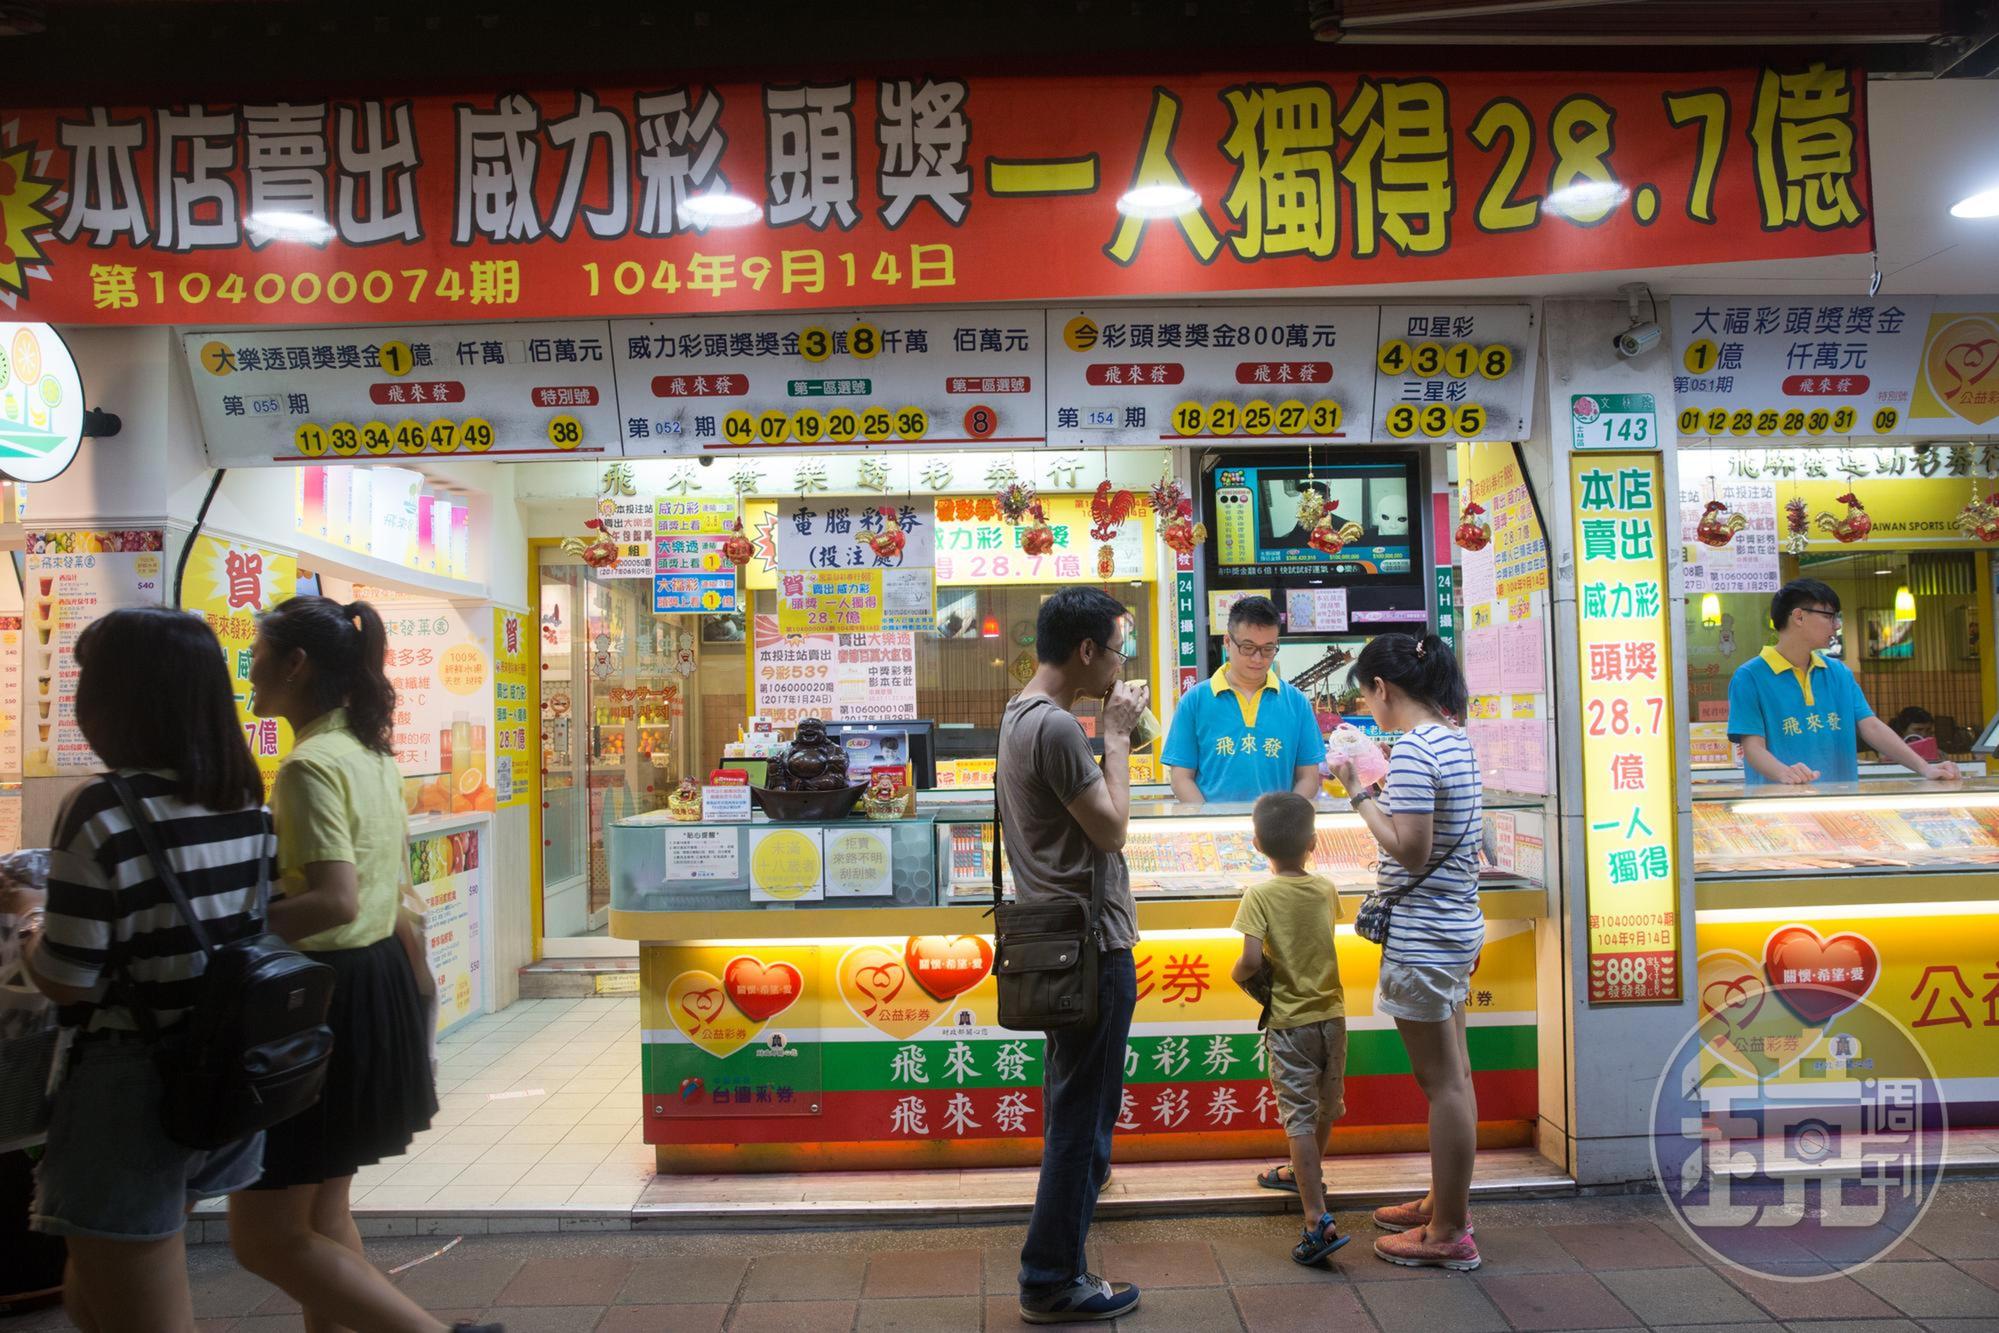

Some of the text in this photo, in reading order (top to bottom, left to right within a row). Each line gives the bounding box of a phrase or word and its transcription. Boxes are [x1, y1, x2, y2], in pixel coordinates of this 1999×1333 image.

[57, 100, 424, 250] 本店賣出
[454, 91, 727, 243] 威力彩
[765, 80, 971, 231] 頭獎
[90, 242, 956, 310] 第104000074期 104年9月14日
[1408, 316, 1475, 338] 四星彩
[1691, 306, 1906, 335] 大福彩頭獎獎金
[953, 327, 1029, 353] 佰萬元
[1074, 323, 1336, 350] 今彩頭獎獎金800萬元
[456, 340, 505, 365] 仟萬
[529, 338, 603, 364] 佰萬元
[1383, 345, 1505, 373] 4 3 1 8
[1786, 342, 1868, 370] 仟萬元
[1104, 365, 1169, 384] 飛來發
[1253, 363, 1318, 383] 飛來發
[389, 383, 450, 402] 飛來發
[669, 376, 733, 395] 飛來發
[793, 380, 867, 396] 第一區選號
[952, 377, 1026, 393] 第二區選號
[1401, 381, 1467, 402] 三星彩
[1799, 376, 1854, 394] 飛來發
[541, 387, 593, 406] 特別號
[726, 413, 923, 438] 04 07 19 20 25 36
[973, 410, 989, 434] 8
[1179, 405, 1338, 427] 18 21 25 27 31
[1393, 407, 1479, 430] 3 3 5
[1682, 409, 1853, 431] 01 12 23 25 28 30 31
[1875, 410, 1896, 430] 09
[300, 424, 491, 450] 11 33 34 46 47 49
[552, 422, 579, 443] 38
[1603, 418, 1648, 441] 143
[1580, 469, 1652, 511] 本店
[1722, 486, 1773, 499] 本投注站
[617, 504, 653, 514] 本投注站
[658, 502, 699, 515] 威力彩
[792, 506, 923, 536] 電腦彩券
[1871, 520, 1945, 532] AIWAN SPORTS
[658, 540, 699, 553] 大樂透
[1582, 519, 1654, 561] 賣出
[1735, 545, 1776, 555] 影本在此
[628, 545, 640, 557] 組
[970, 555, 1081, 578] 28.7億
[1710, 571, 1778, 581] 第106000010期
[137, 582, 154, 590] $40
[225, 550, 264, 611] 賀
[657, 578, 699, 592] 大福彩
[782, 574, 804, 597] 賀
[812, 583, 871, 594] 賣出 威力彩
[791, 596, 877, 609] 頭獎 一人獨得
[1583, 581, 1661, 620] 威力彩
[808, 611, 861, 625] 28.7億
[838, 633, 911, 647] 賣出大樂透
[760, 649, 832, 662] 本投注站賣出
[1589, 641, 1658, 682] 頭獎
[761, 665, 829, 680] 今彩539
[868, 665, 913, 677] 中獎彩券
[760, 682, 834, 694] 第106000020期
[868, 677, 913, 687] 影本在此
[761, 694, 832, 705] (2017年1月24日)
[840, 703, 914, 715] 第106000010期
[1587, 697, 1664, 737] 28.7
[1782, 711, 1842, 737] 飛來發
[499, 727, 526, 750] 28.7億
[1216, 733, 1284, 759] 飛來發
[1610, 753, 1645, 791] 億
[1593, 806, 1654, 840] 一人
[832, 852, 884, 866] 來路不明
[1608, 845, 1669, 885] 獨得
[839, 868, 877, 881] 刮刮樂
[1590, 911, 1675, 929] 第104000074期
[1598, 929, 1670, 946] 104年9月14日
[1606, 957, 1648, 985] 888
[1783, 966, 1865, 984] 關懷·希望·愛
[878, 1008, 930, 1023] 公益彩券
[1734, 1035, 1800, 1052] 公益彩券
[890, 1040, 1036, 1084] 飛來發
[890, 1091, 1036, 1136] 飛來發
